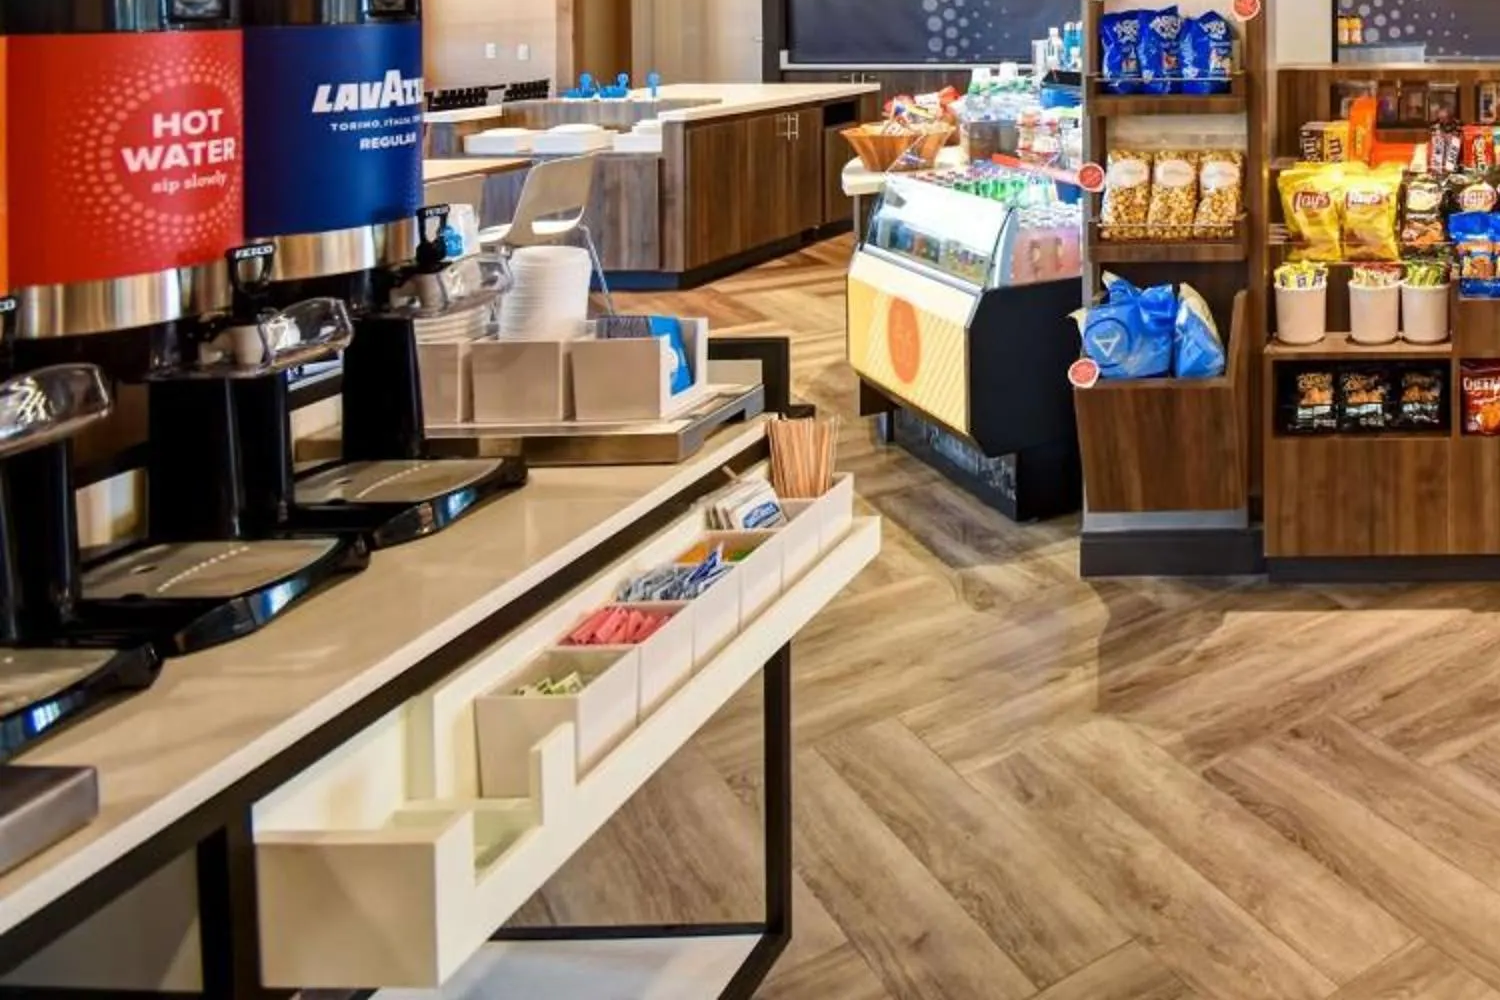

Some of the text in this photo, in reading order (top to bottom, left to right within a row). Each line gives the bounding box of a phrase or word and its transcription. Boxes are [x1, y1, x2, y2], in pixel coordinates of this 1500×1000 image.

[152, 108, 224, 139] HOT
[121, 136, 236, 173] WATER
[360, 132, 417, 151] REGULAR
[151, 169, 228, 196] sip slowly
